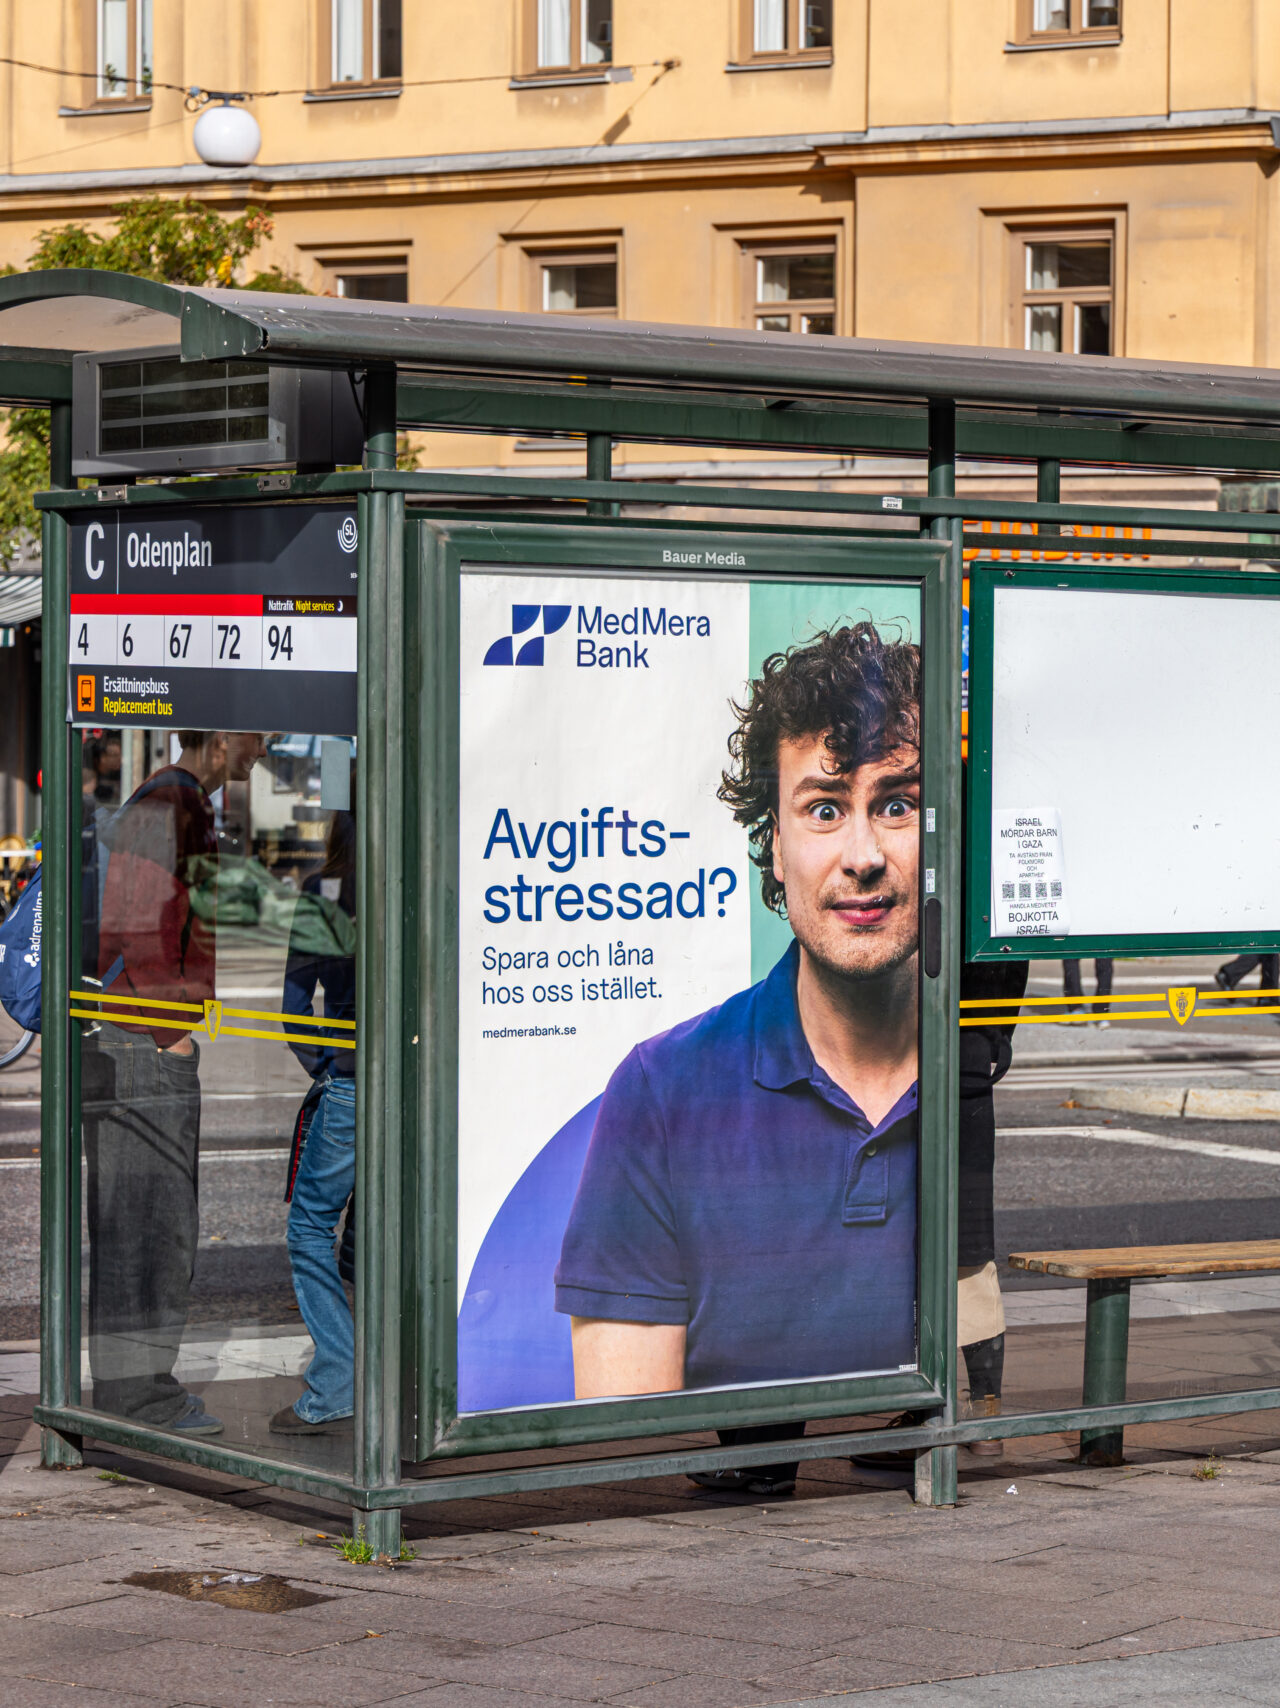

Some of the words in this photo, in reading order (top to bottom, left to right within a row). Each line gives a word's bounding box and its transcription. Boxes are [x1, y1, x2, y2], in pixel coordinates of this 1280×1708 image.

[85, 521, 105, 581] C
[126, 531, 213, 576] Odenplan
[662, 550, 702, 565] Bauer
[705, 551, 746, 566] Media
[268, 600, 294, 612] Nattrafik
[295, 600, 311, 613] Night
[312, 600, 335, 612] services
[576, 606, 711, 637] MedMera
[77, 622, 89, 656] 4
[122, 623, 134, 657] 6
[169, 624, 192, 658] 67
[217, 624, 241, 660] 72
[268, 625, 293, 661] 94
[576, 639, 650, 669] Bank
[103, 675, 169, 697] Ersättningsbuss
[103, 697, 156, 717] Replacement
[157, 700, 173, 716] bus
[1001, 828, 1035, 838] MÖRDAR
[1036, 828, 1058, 837] BARN
[1016, 818, 1042, 827] ISRAEL
[483, 806, 690, 872] Avgifts-
[1022, 840, 1043, 849] GAZA
[483, 866, 738, 925] stressad?
[1008, 911, 1059, 922] BOJKOTTA
[1016, 924, 1050, 935] ISRAEL
[482, 946, 550, 976] Spara
[557, 944, 600, 968] och
[608, 941, 654, 967] låna
[482, 980, 527, 1006] hos
[533, 985, 574, 1003] oss
[581, 977, 663, 1003] istället.
[482, 1023, 577, 1039] medmerabank.se
